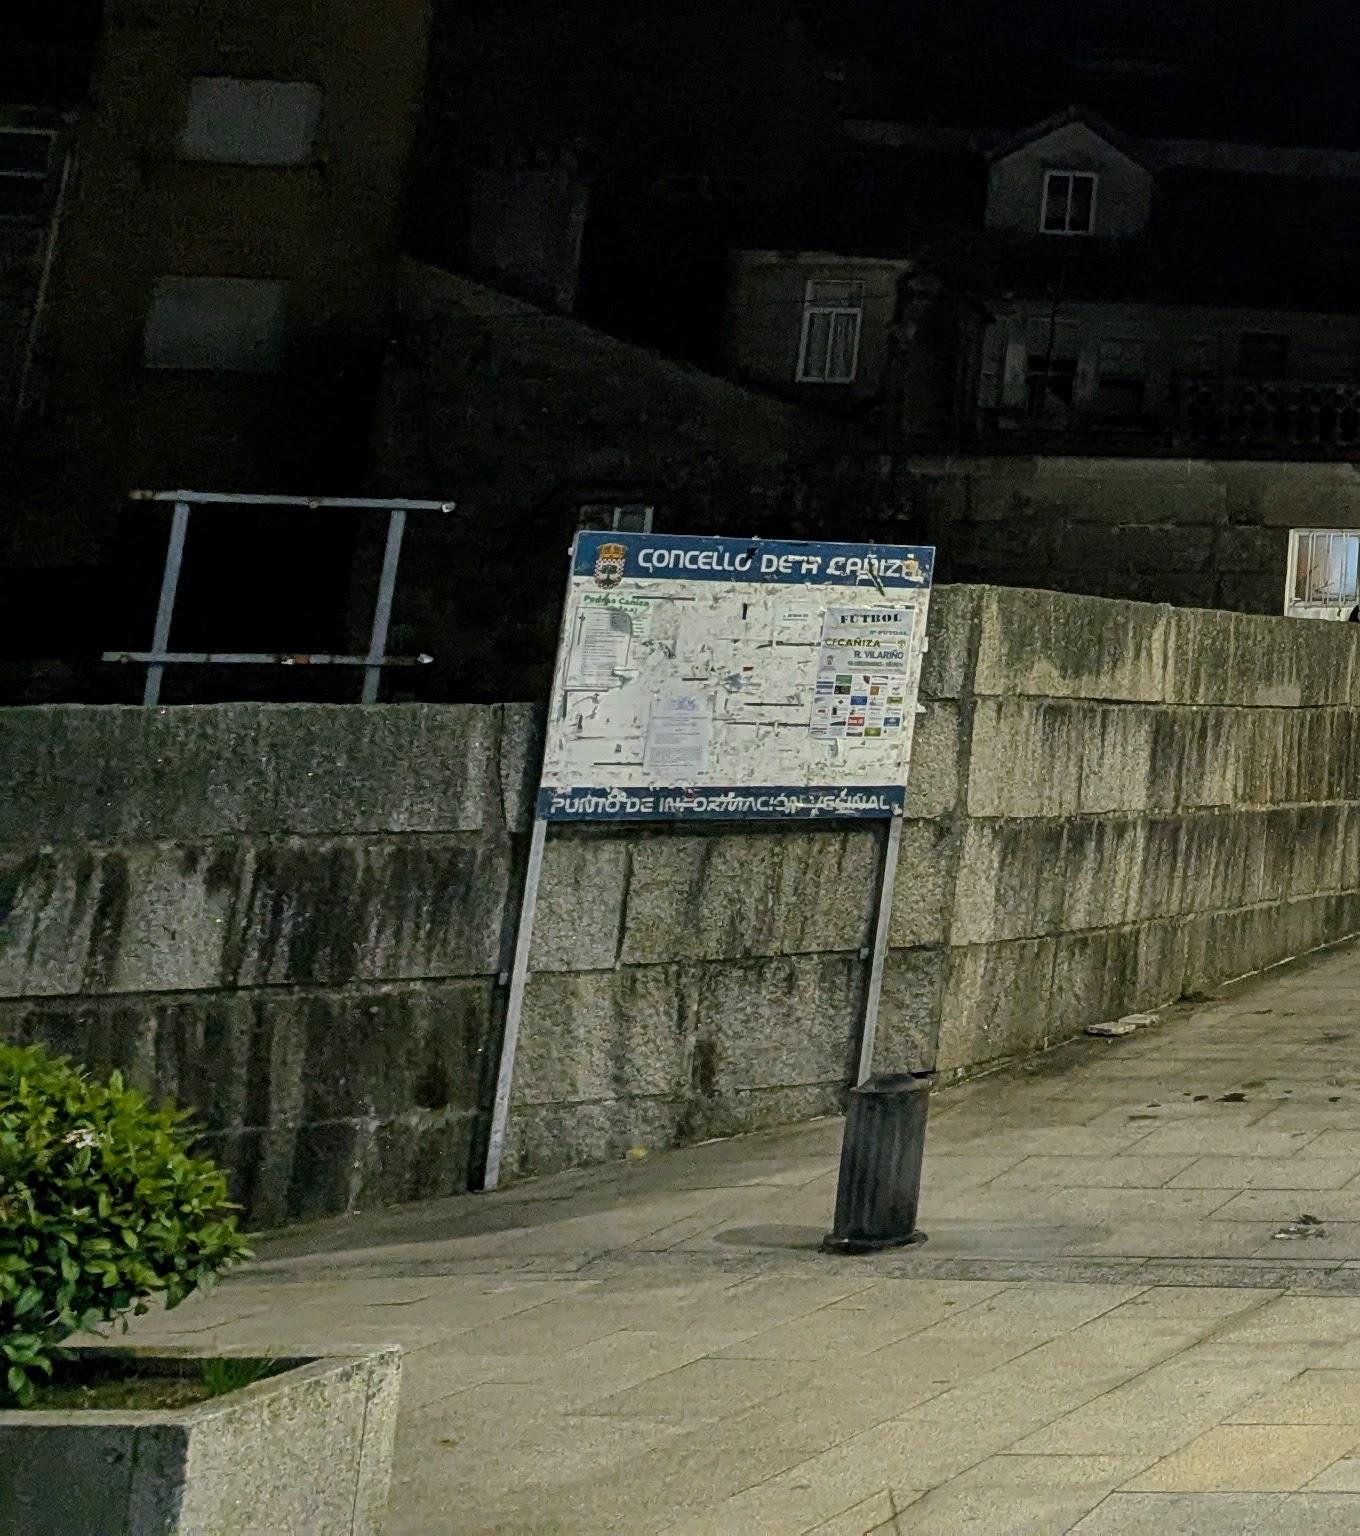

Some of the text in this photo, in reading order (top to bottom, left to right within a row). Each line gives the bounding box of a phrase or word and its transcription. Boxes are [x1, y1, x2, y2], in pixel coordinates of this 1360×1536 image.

[638, 549, 751, 573] CONCELLO
[760, 554, 793, 574] DE
[551, 797, 620, 814] PUNTO
[625, 797, 654, 813] DE
